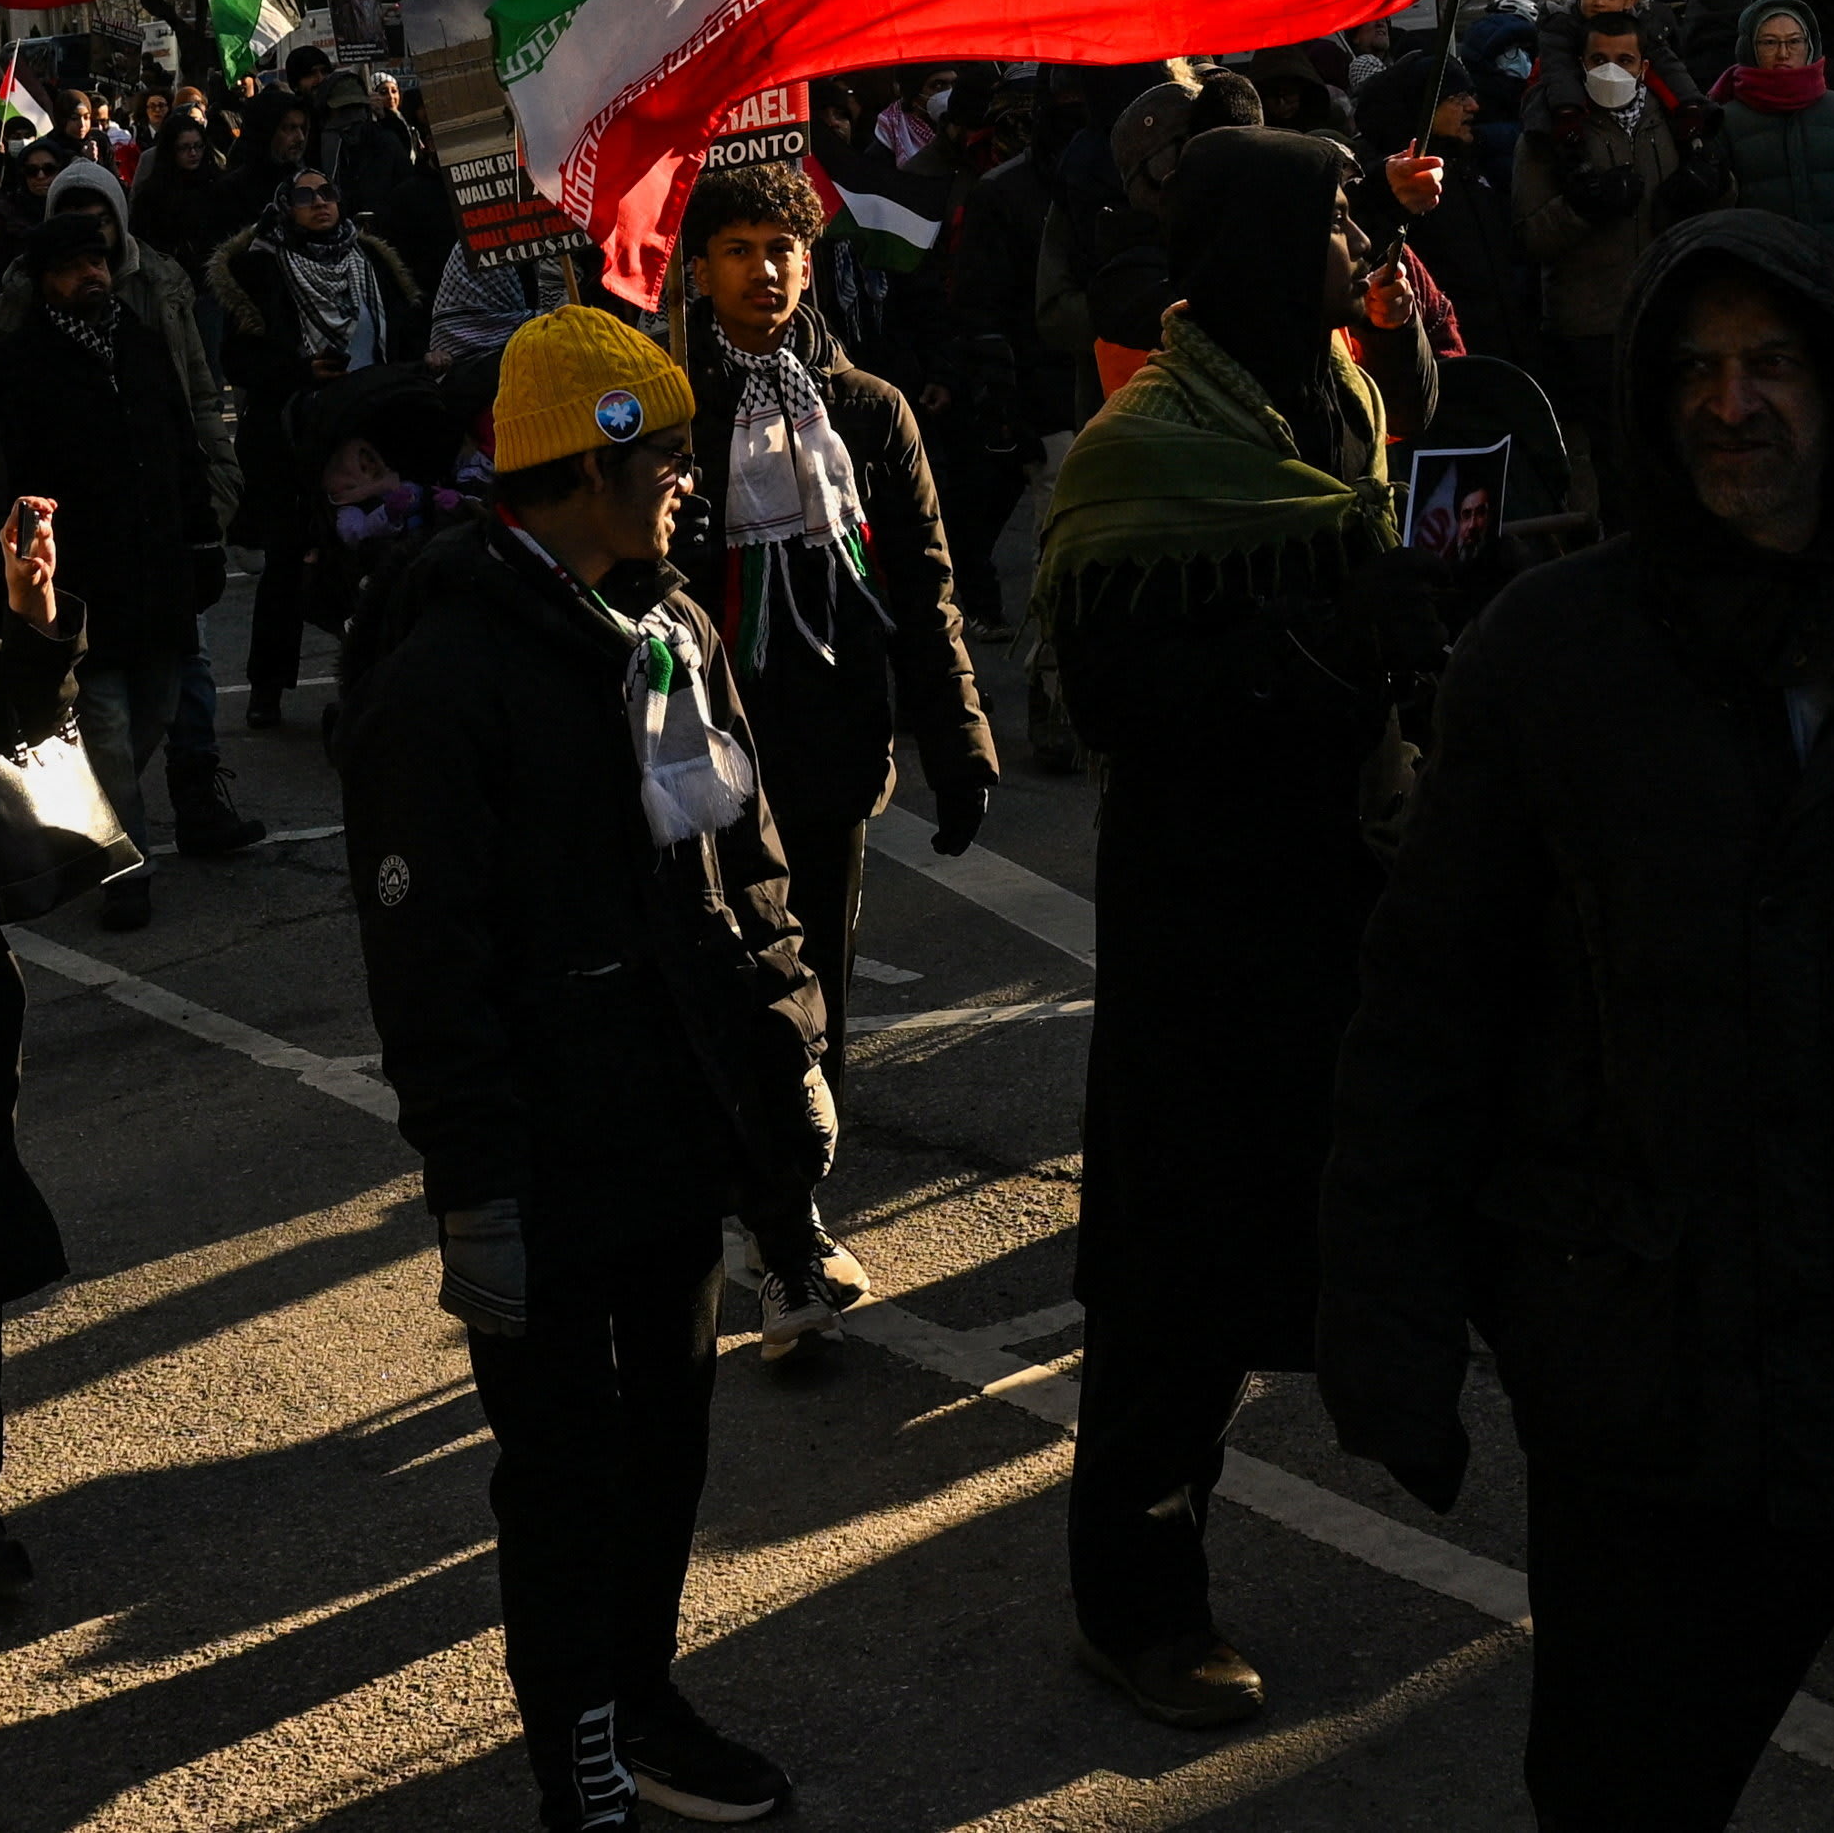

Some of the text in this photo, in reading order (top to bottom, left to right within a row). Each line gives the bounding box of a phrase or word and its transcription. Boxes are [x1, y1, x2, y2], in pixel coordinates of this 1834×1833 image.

[450, 152, 516, 183] BRICK BY
[455, 177, 514, 206] WALL BY
[477, 238, 557, 269] AL-QUDS
